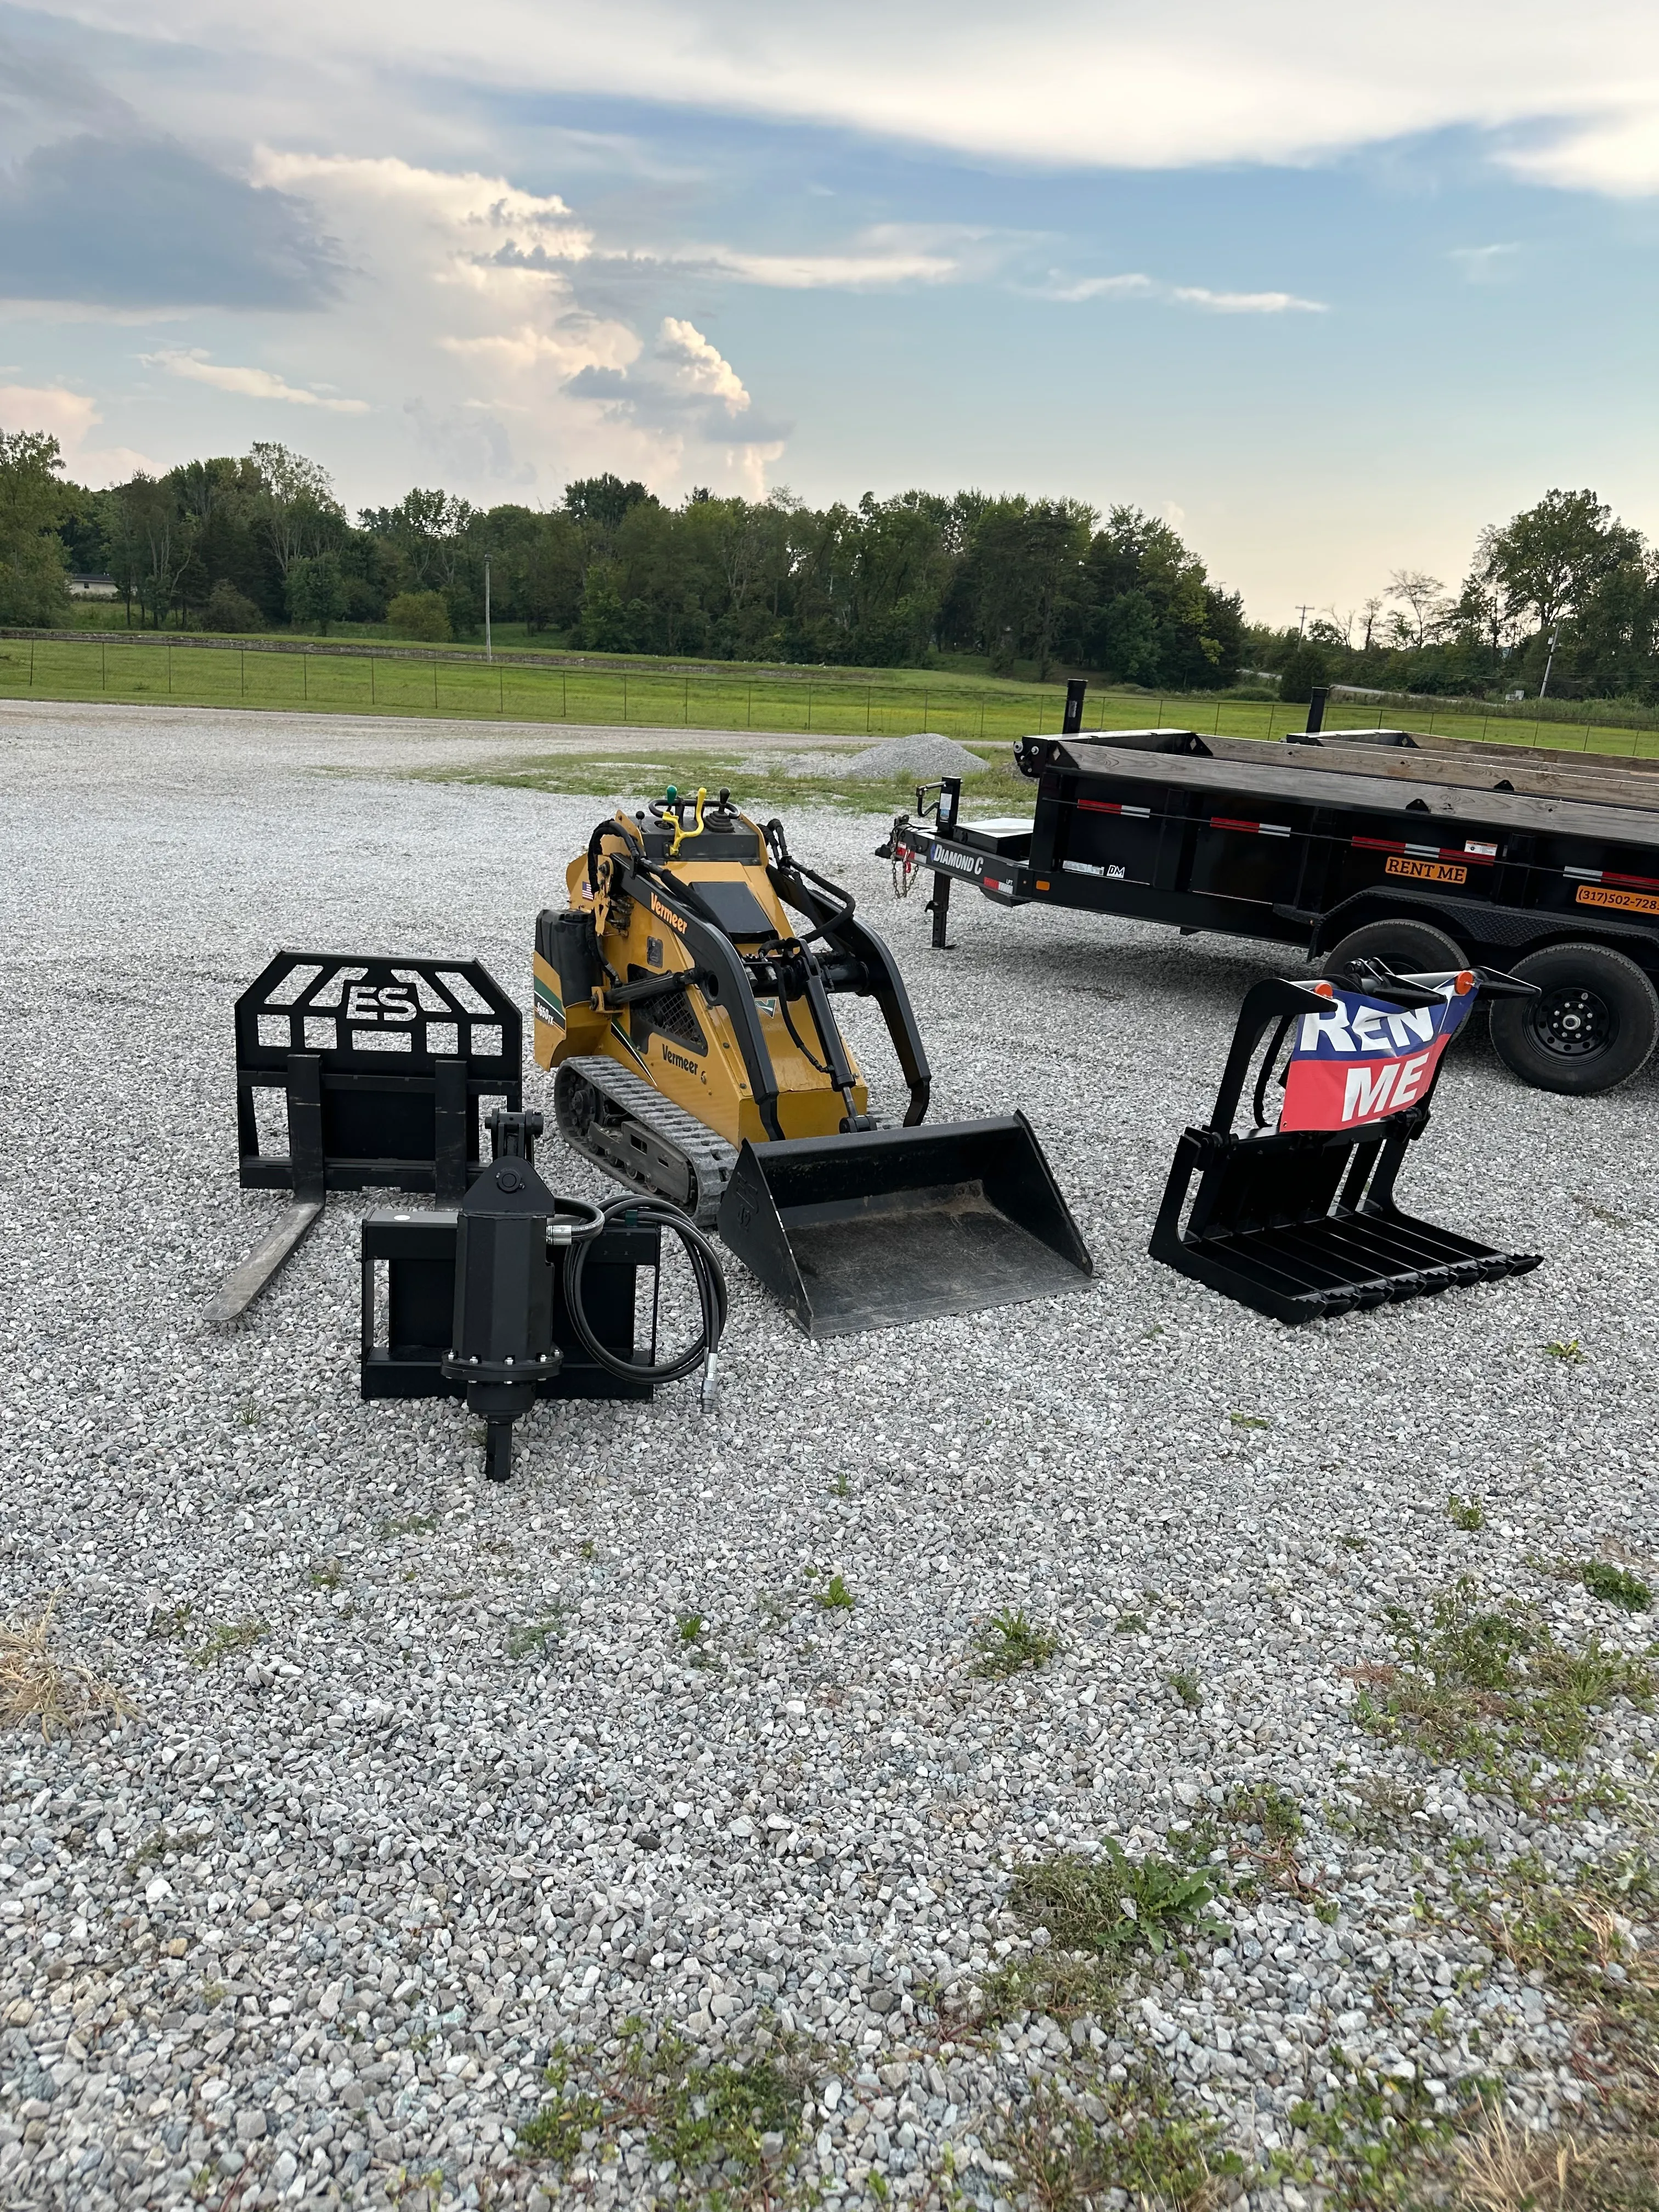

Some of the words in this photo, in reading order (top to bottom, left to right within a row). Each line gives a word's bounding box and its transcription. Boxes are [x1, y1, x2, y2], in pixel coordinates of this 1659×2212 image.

[933, 844, 974, 872] DIAMOND
[974, 856, 984, 875] C
[1108, 865, 1125, 878] DM
[1387, 859, 1435, 878] RENT
[1436, 866, 1465, 882] ME
[651, 891, 688, 935] Vermeer
[1578, 889, 1659, 911] (317)502-728
[346, 985, 417, 1022] ES
[537, 1001, 554, 1026] S650TX
[662, 1043, 698, 1076] Vermeer
[1341, 1052, 1430, 1122] ME
